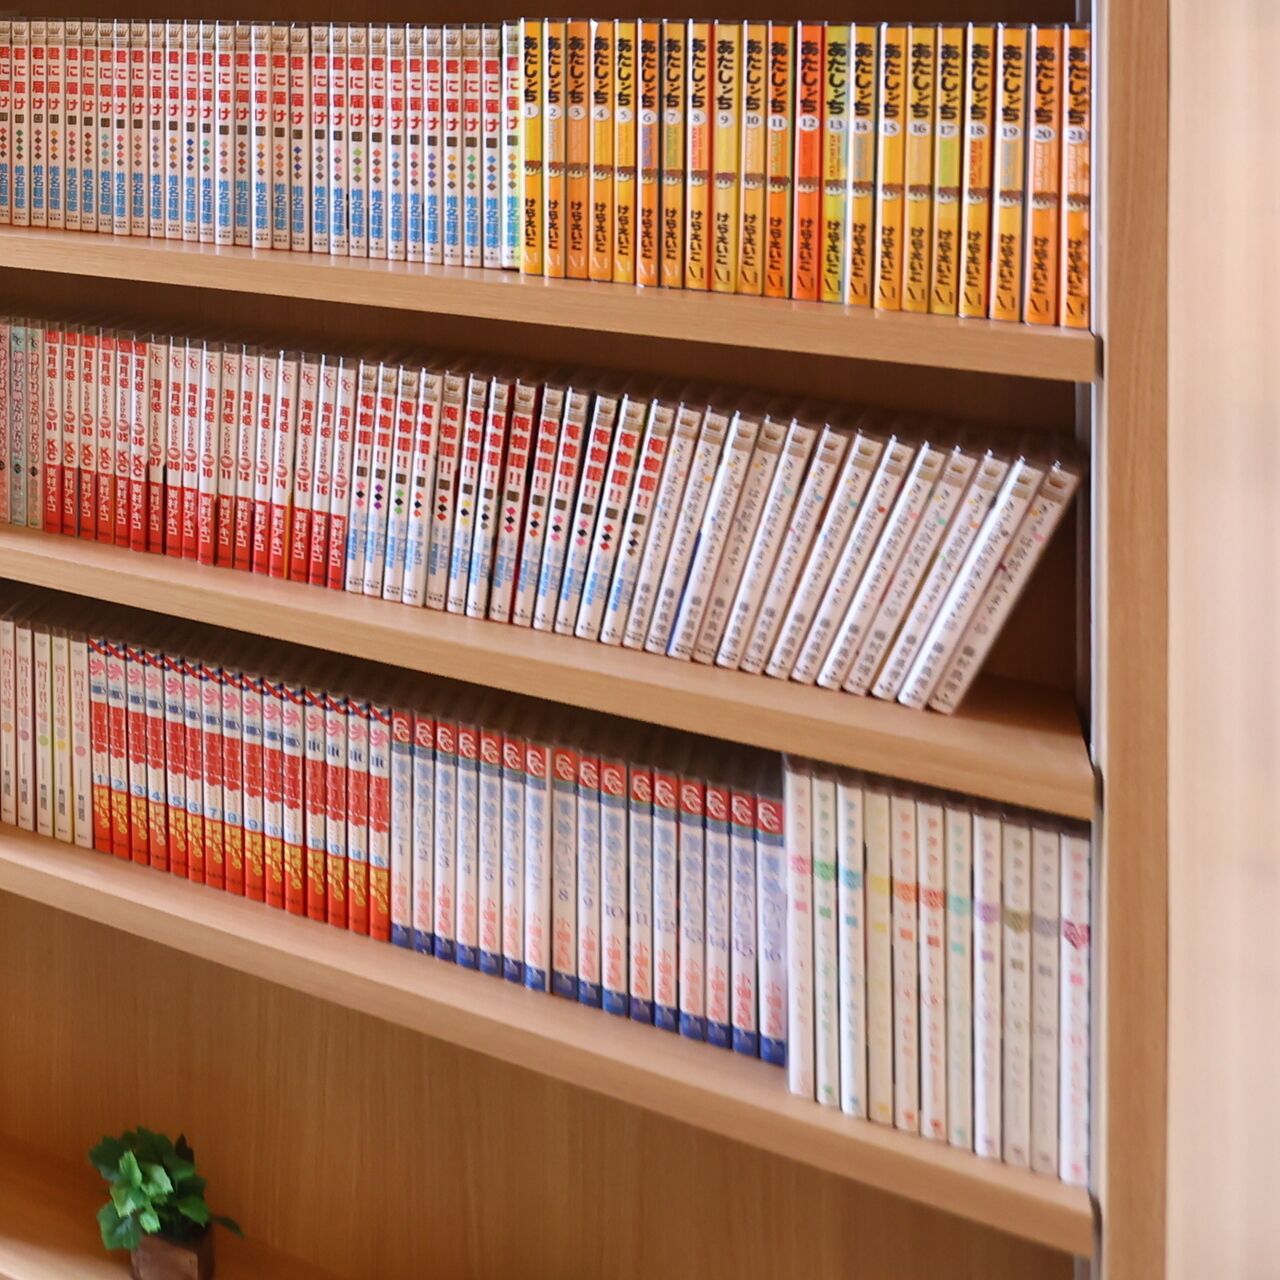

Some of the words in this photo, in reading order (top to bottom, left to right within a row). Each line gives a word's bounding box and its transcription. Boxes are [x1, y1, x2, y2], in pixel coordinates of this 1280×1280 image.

[15, 48, 25, 109] 君に届け
[33, 47, 44, 109] 君に届け
[49, 47, 60, 109] 君に届け
[67, 49, 78, 111] 君に届け
[83, 49, 94, 111] 君に届け
[132, 51, 144, 114] 君に届け
[219, 53, 231, 120] 君に届け
[237, 53, 249, 120] 君に届け
[255, 54, 267, 121] 君に届け
[292, 56, 304, 124] 君に届け
[314, 56, 327, 124] 君に届け
[350, 56, 364, 127] 君に届け
[524, 36, 538, 102] あたしンち
[548, 36, 561, 103] あたしンち
[569, 37, 585, 104] あたしンち
[594, 37, 609, 104] あたしンち
[618, 38, 631, 105] あたしンち
[641, 40, 656, 107] あたしンち
[666, 39, 681, 107] あたしンち
[692, 38, 705, 108] あたしンち
[718, 40, 734, 110] あたしンち
[746, 40, 762, 111] あたしンち
[770, 42, 787, 113] あたしンち
[801, 41, 817, 113] あたしンち
[827, 42, 845, 114] あたしンち
[854, 42, 872, 116] あたしンち
[884, 43, 900, 118] あたしンち
[912, 43, 930, 118] あたしンち
[941, 44, 959, 120] あたしンち
[971, 44, 988, 120] あたしンち
[1003, 45, 1022, 121] あたしンち
[1036, 46, 1054, 123] あたしンち
[1069, 47, 1085, 124] あたしンち
[447, 60, 458, 131] 君に届け
[464, 60, 479, 131] 君に届け
[485, 60, 499, 132] 君に届け
[551, 107, 556, 116] 2
[574, 107, 579, 116] 3
[597, 109, 603, 118] 4
[621, 110, 627, 119] 5
[644, 112, 651, 121] 6
[669, 112, 675, 121] 7
[694, 112, 700, 121] 8
[721, 115, 728, 123] 9
[747, 116, 758, 125] 10
[771, 119, 783, 127] 11
[829, 121, 843, 129] 13
[855, 123, 867, 131] 14
[883, 124, 896, 132] 15
[913, 125, 926, 133] 16
[940, 126, 953, 135] 17
[970, 126, 983, 135] 18
[1003, 128, 1016, 136] 19
[1035, 130, 1050, 139] 20
[1069, 132, 1083, 140] 21
[525, 199, 536, 247] けらえいこ
[571, 202, 581, 250] けらえいこ
[595, 203, 606, 252] けらえいこ
[642, 209, 653, 259] けらえいこ
[691, 210, 702, 261] けらえいこ
[718, 213, 729, 265] けらえいこ
[770, 217, 781, 270] けらえいこ
[827, 221, 839, 273] けらえいこ
[911, 227, 924, 283] けらえいこ
[1000, 234, 1014, 291] けらえいこ
[48, 346, 57, 378] 海月姫
[65, 347, 74, 380] 海月姫
[83, 347, 92, 383] 海月姫
[101, 353, 111, 385] 海月姫
[152, 379, 161, 412] 海月姫
[171, 383, 180, 416] 海月姫
[205, 389, 215, 422] 海月姫
[224, 389, 234, 424] 海月姫
[243, 391, 252, 425] 海月姫
[262, 394, 271, 429] 海月姫
[301, 400, 312, 435] 海月姫
[47, 422, 56, 431] 01
[64, 424, 74, 432] 02
[82, 427, 92, 436] 03
[339, 406, 350, 441] 海月姫
[150, 457, 161, 466] 07
[168, 461, 179, 470] 08
[203, 467, 212, 478] 10
[221, 470, 230, 479] 11
[239, 472, 249, 481] 12
[297, 482, 308, 492] 15
[335, 489, 345, 499] 17
